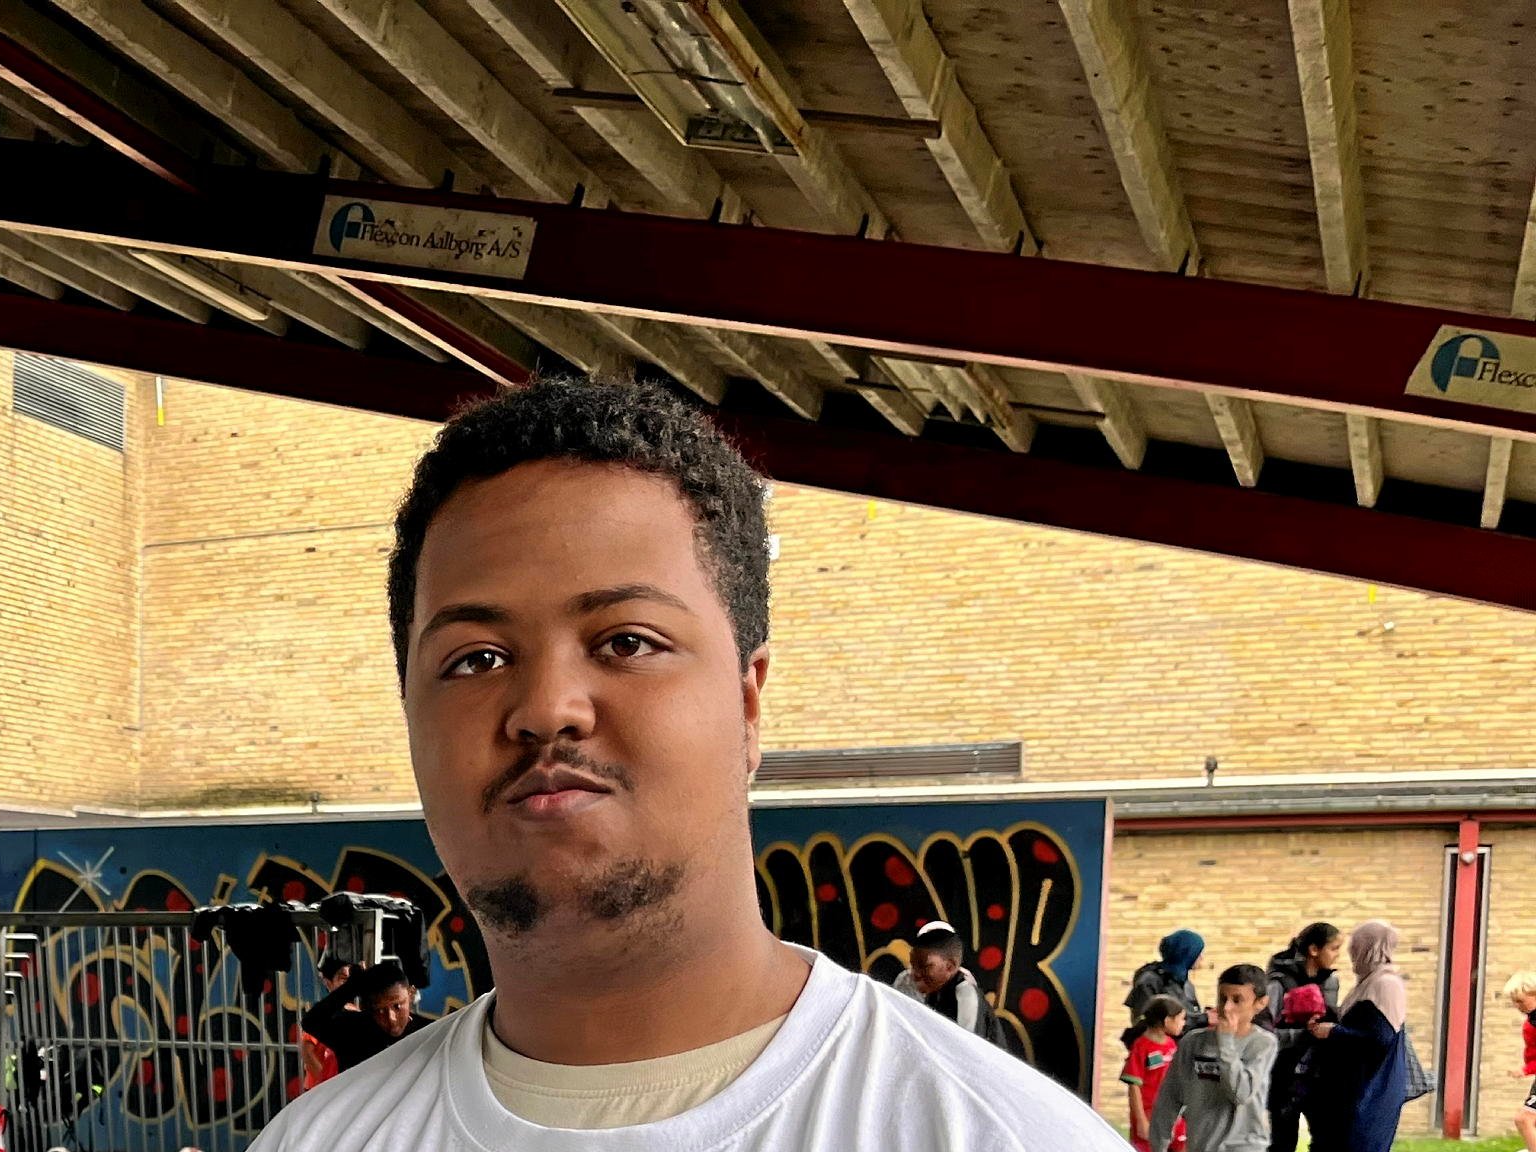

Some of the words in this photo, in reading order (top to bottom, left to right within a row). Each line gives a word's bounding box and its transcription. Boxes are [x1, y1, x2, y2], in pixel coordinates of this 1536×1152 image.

[359, 223, 420, 247] Flexcon
[423, 230, 486, 260] Aalborg
[487, 239, 523, 259] A/S
[1477, 361, 1536, 388] Flexc
